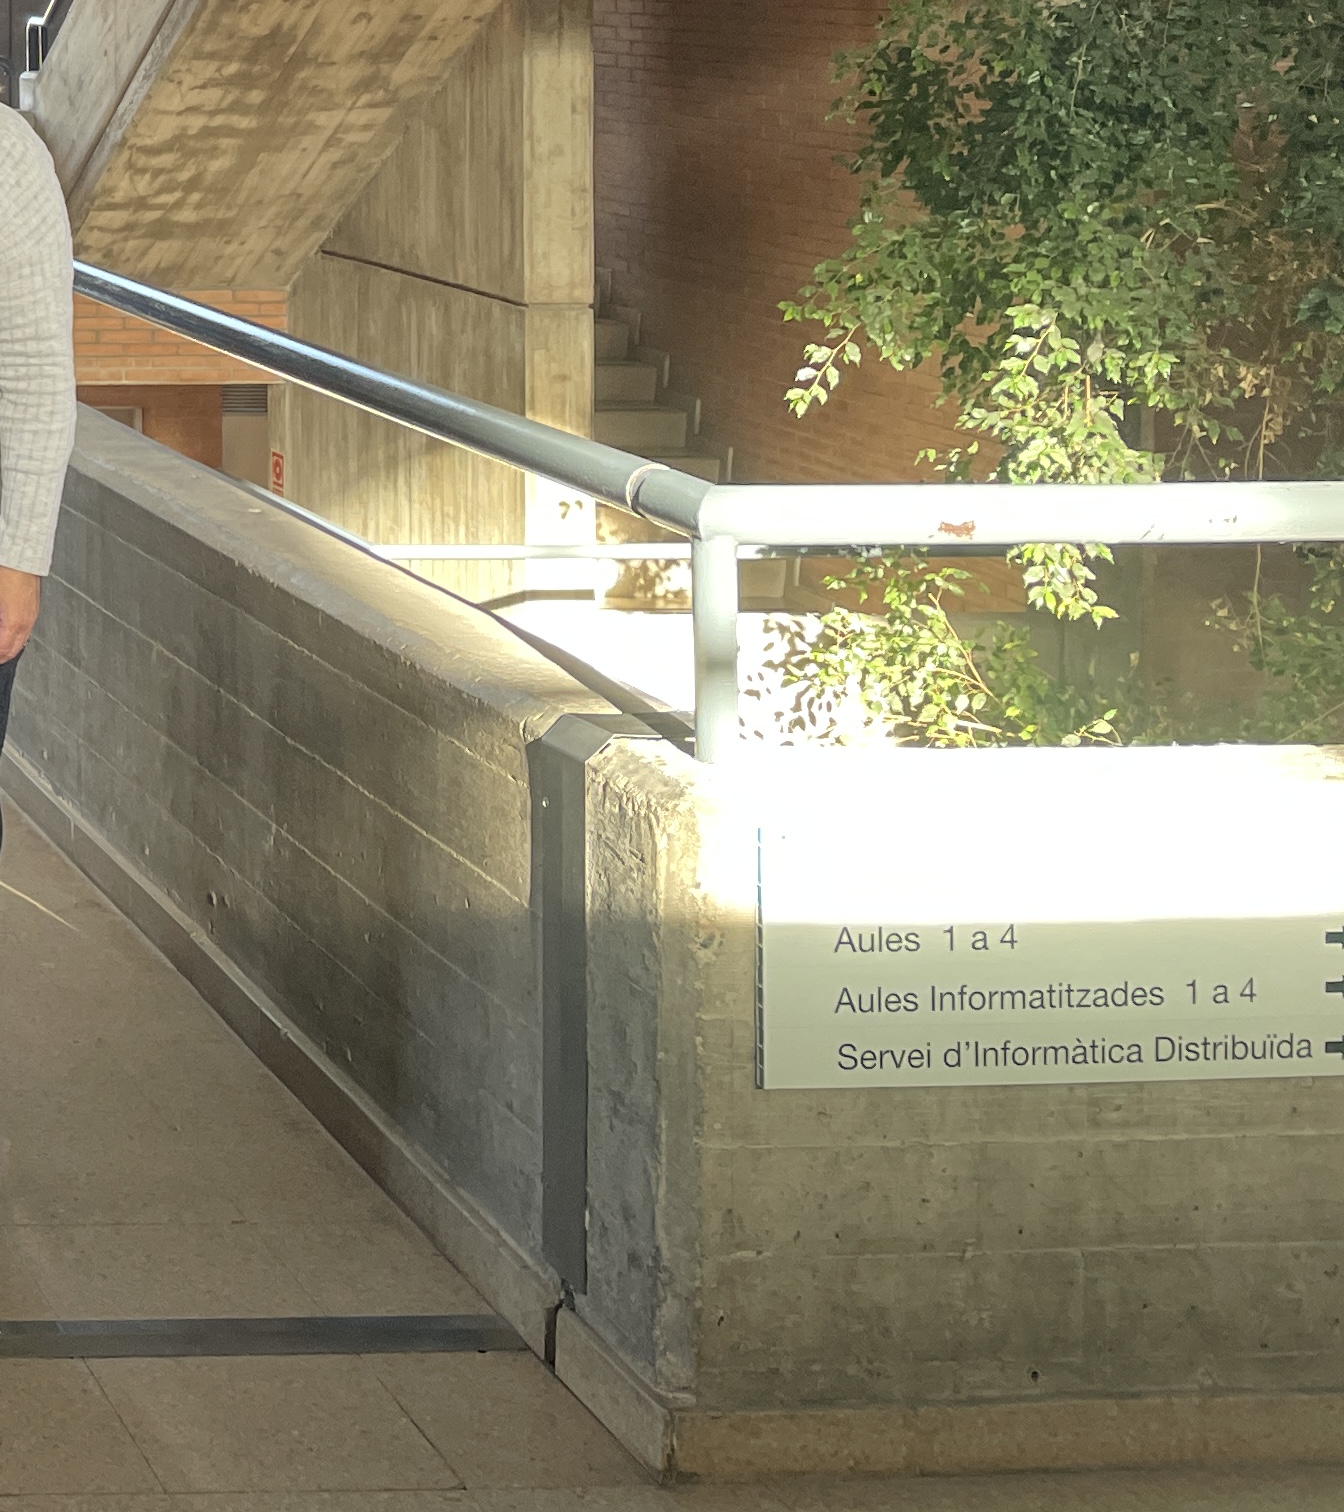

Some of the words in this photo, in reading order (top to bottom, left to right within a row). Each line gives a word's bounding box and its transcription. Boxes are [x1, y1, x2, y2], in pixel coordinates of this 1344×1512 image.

[833, 926, 921, 953] Aules
[943, 925, 955, 952] 1
[971, 930, 990, 951] a
[999, 923, 1018, 950] 4
[834, 986, 920, 1014] Aules
[930, 980, 1165, 1012] Informatitzades
[1186, 979, 1197, 1005] 1
[1213, 984, 1230, 1004] a
[1239, 977, 1257, 1003] 4
[837, 1041, 931, 1070] Servei
[1155, 1032, 1313, 1063] Distribuïda
